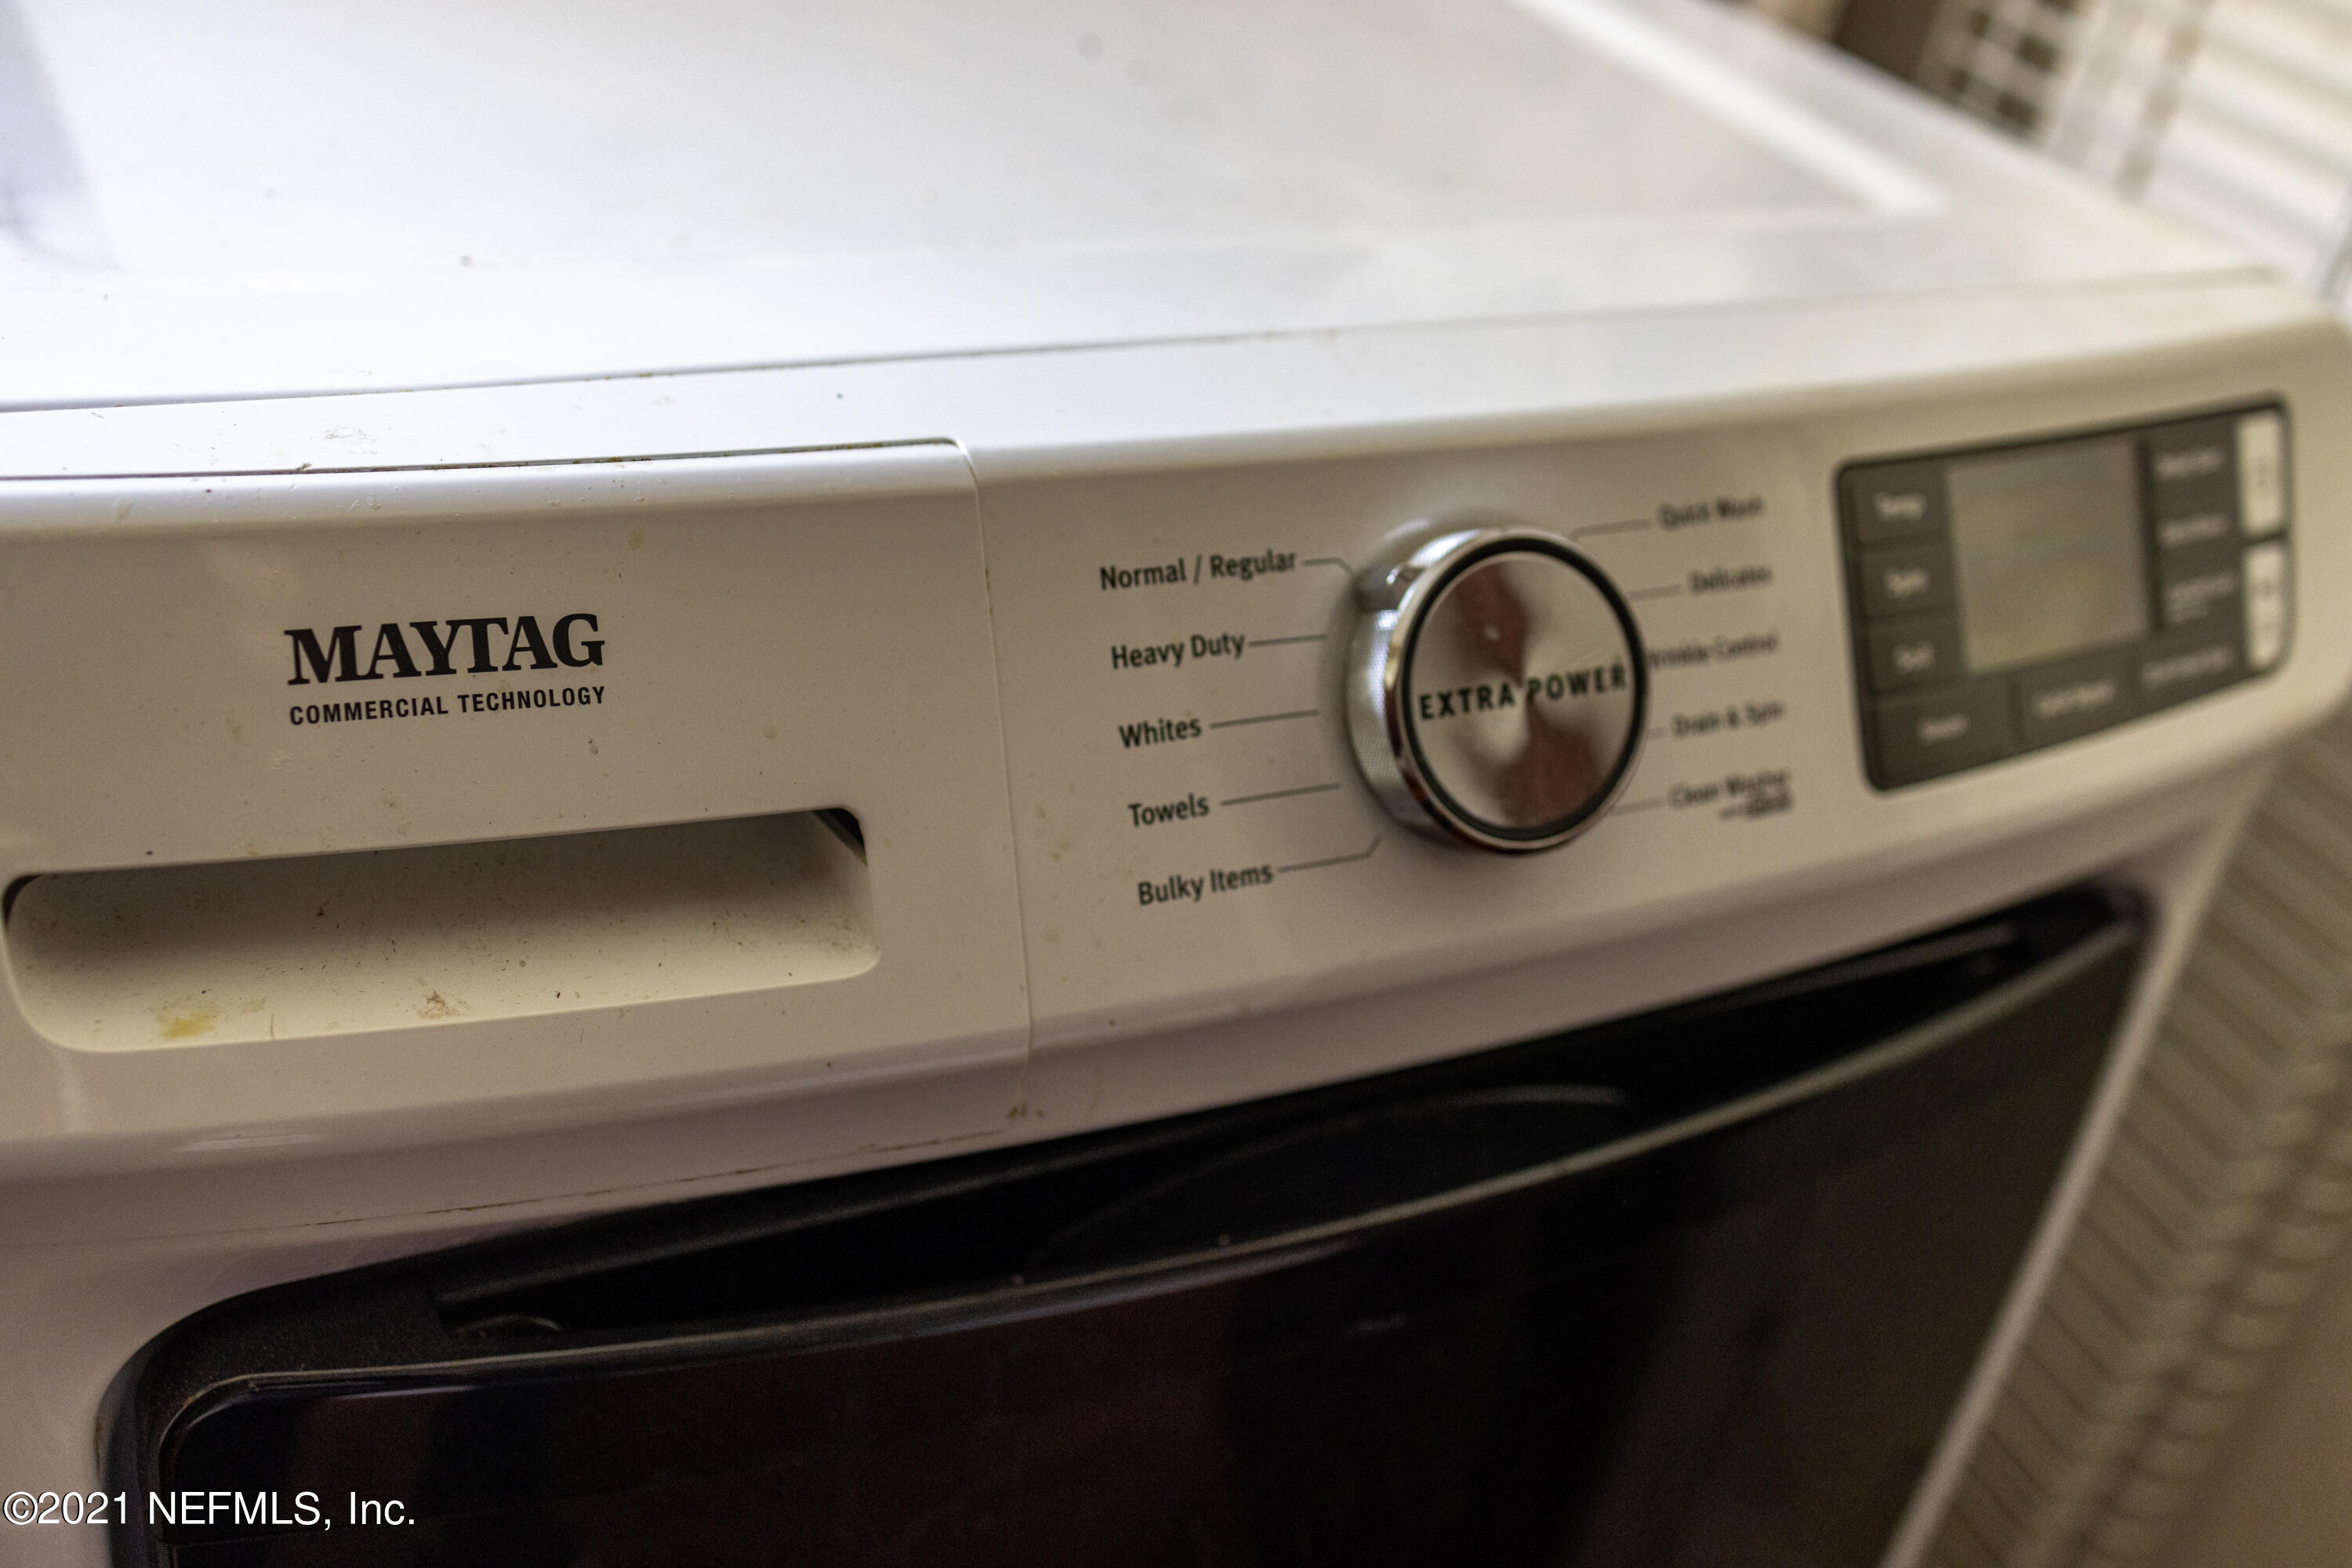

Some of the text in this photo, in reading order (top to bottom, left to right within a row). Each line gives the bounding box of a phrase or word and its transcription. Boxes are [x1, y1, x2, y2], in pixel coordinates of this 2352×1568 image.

[1100, 550, 1297, 590] Normal / Regular
[284, 612, 605, 686] MAYTAG
[1111, 633, 1246, 670] Heavy Duty
[290, 685, 605, 725] COMMERCIAL TECHNOLOGY
[1420, 663, 1628, 720] EXTRA POWER
[1119, 717, 1202, 749] Whites
[1128, 793, 1210, 827] Towels
[1138, 864, 1274, 906] Bulky Items
